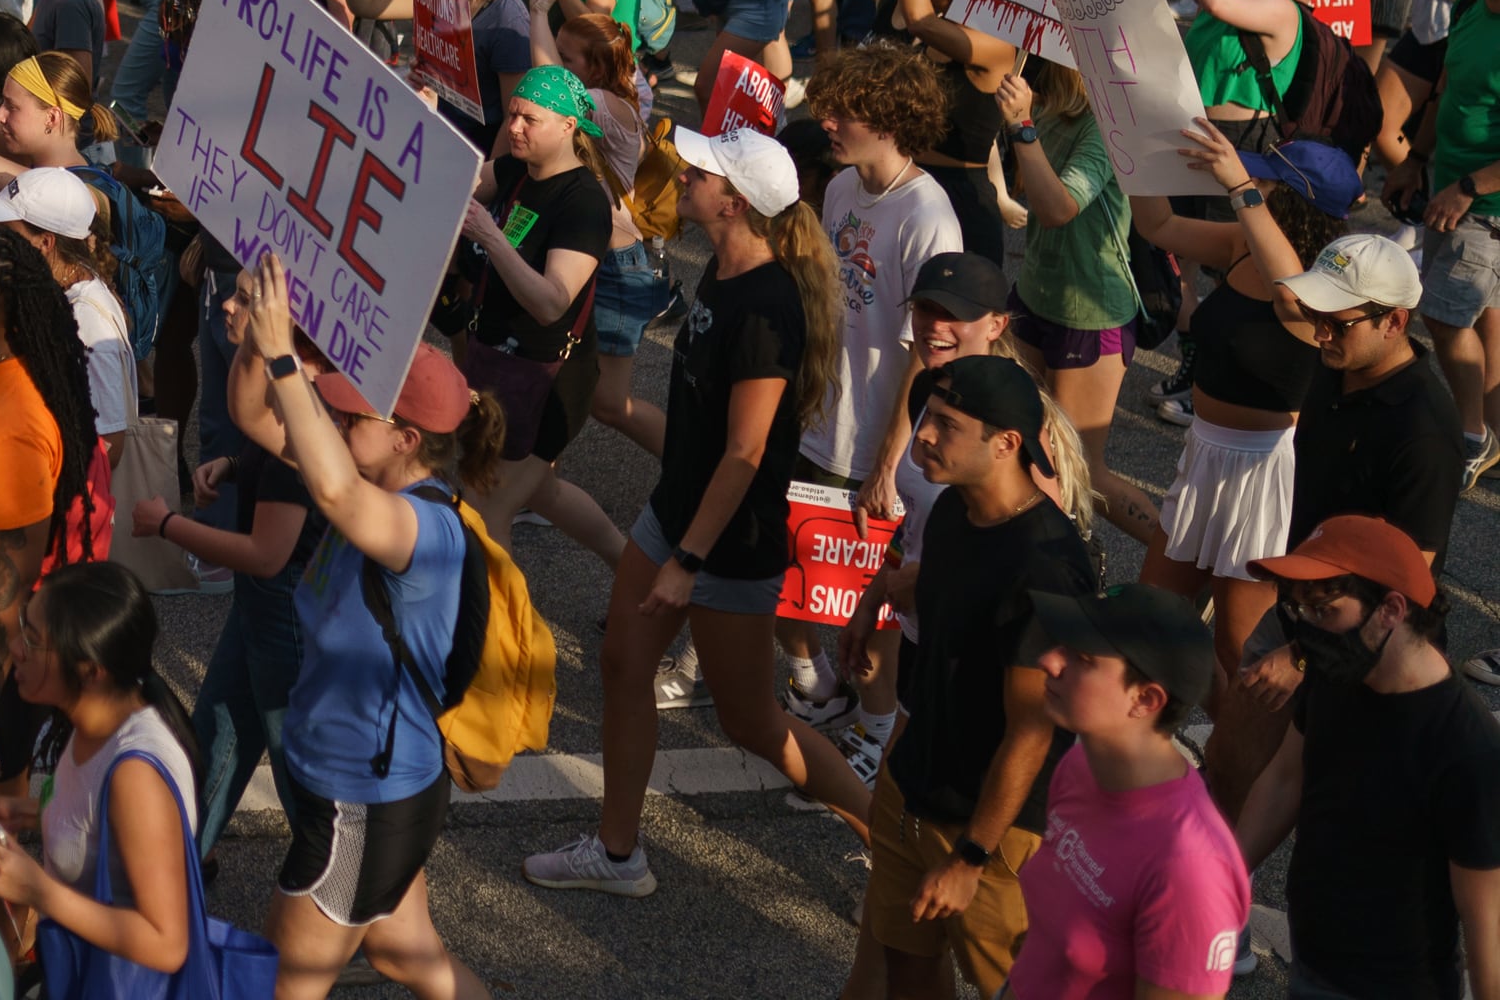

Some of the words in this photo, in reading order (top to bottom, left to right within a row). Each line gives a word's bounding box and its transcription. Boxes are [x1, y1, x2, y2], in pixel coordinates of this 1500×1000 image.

[416, 23, 462, 72] HEALTHCARE
[357, 77, 390, 142] IS
[397, 120, 426, 185] A
[239, 61, 407, 297] LIE
[175, 105, 248, 203] THEY
[258, 192, 328, 277] DON'T
[330, 267, 392, 354] CARE
[187, 173, 224, 213] IF
[327, 318, 374, 388] DIE
[811, 533, 887, 570] HCARE
[809, 584, 859, 619] ONS
[1069, 851, 1116, 909] Parenthood
[1075, 839, 1106, 878] Planned
